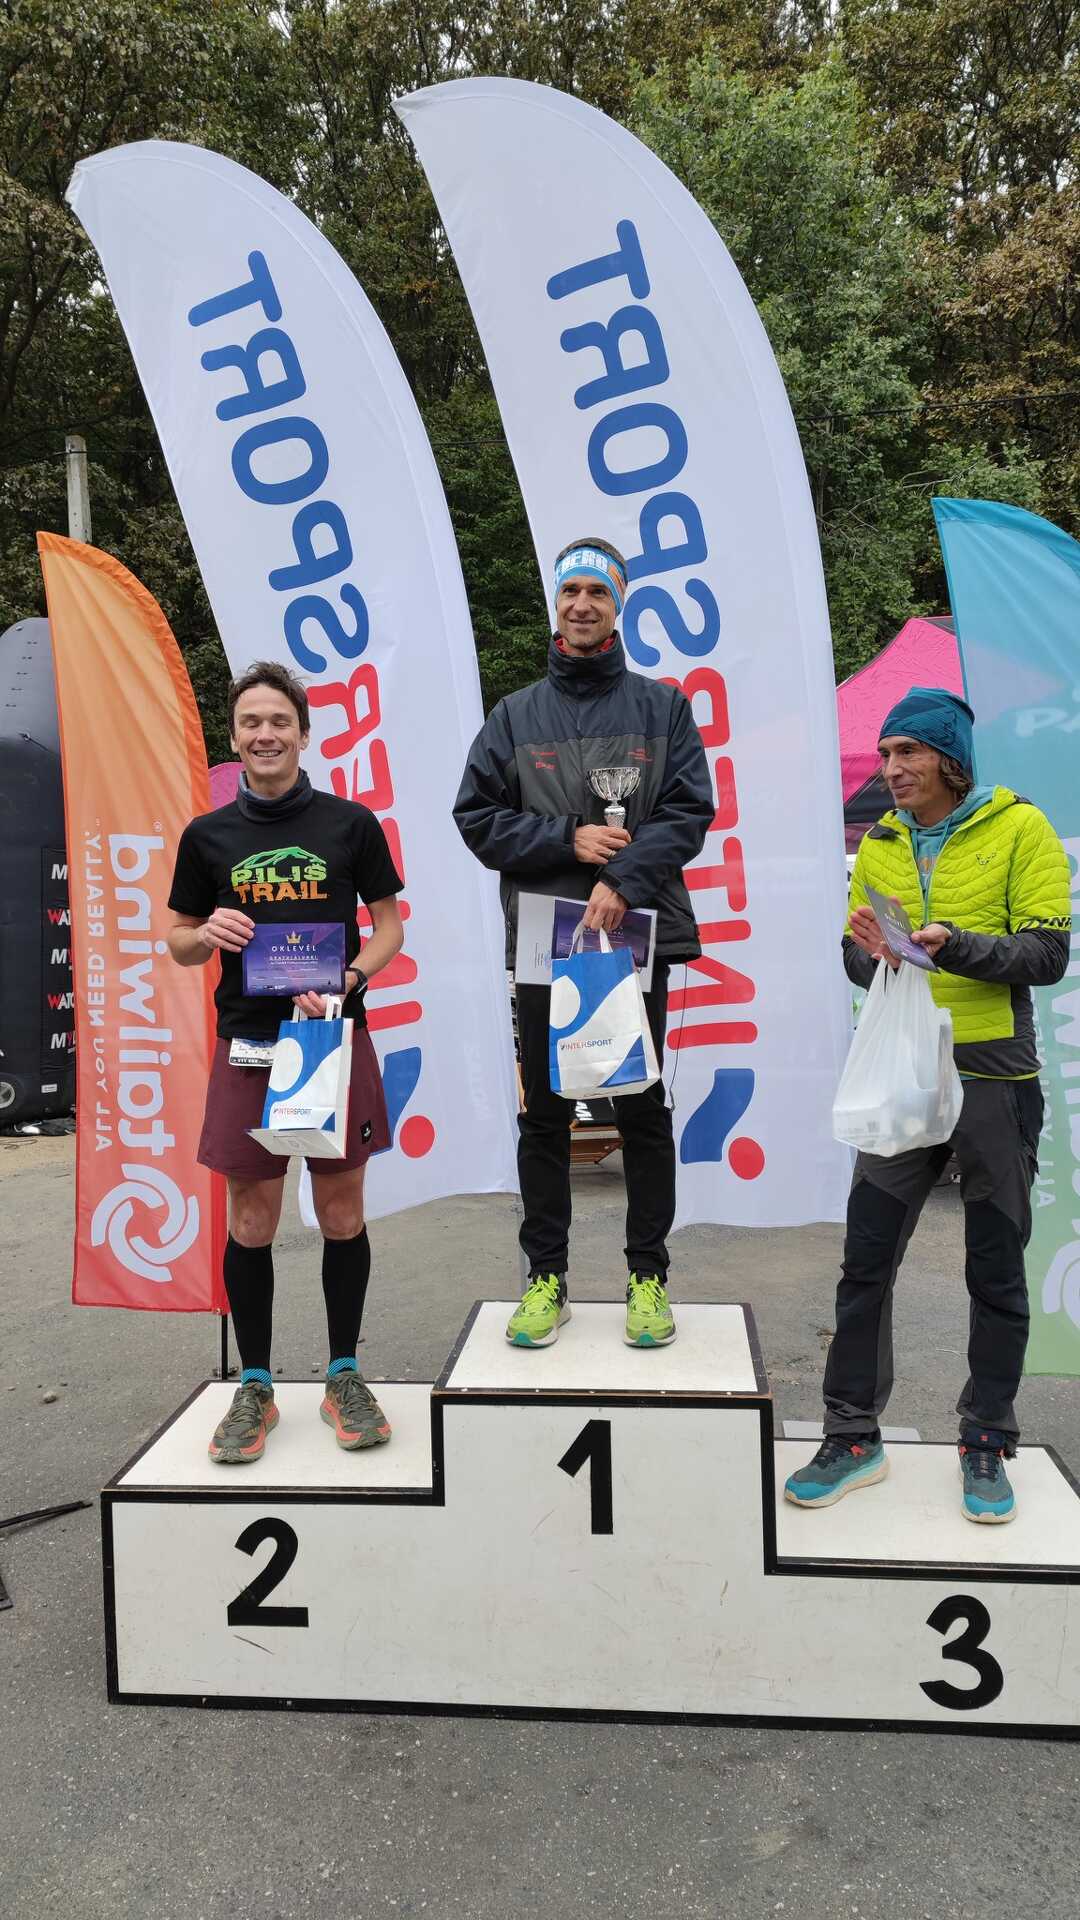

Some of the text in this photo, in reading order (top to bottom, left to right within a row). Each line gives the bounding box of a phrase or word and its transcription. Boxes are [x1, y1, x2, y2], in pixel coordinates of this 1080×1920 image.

[231, 863, 327, 887] PILIS
[233, 880, 329, 904] TRAIL
[565, 1038, 613, 1051] INTERSPORT
[557, 1419, 614, 1536] 1
[227, 1516, 309, 1628] 2
[919, 1594, 1004, 1710] 3
